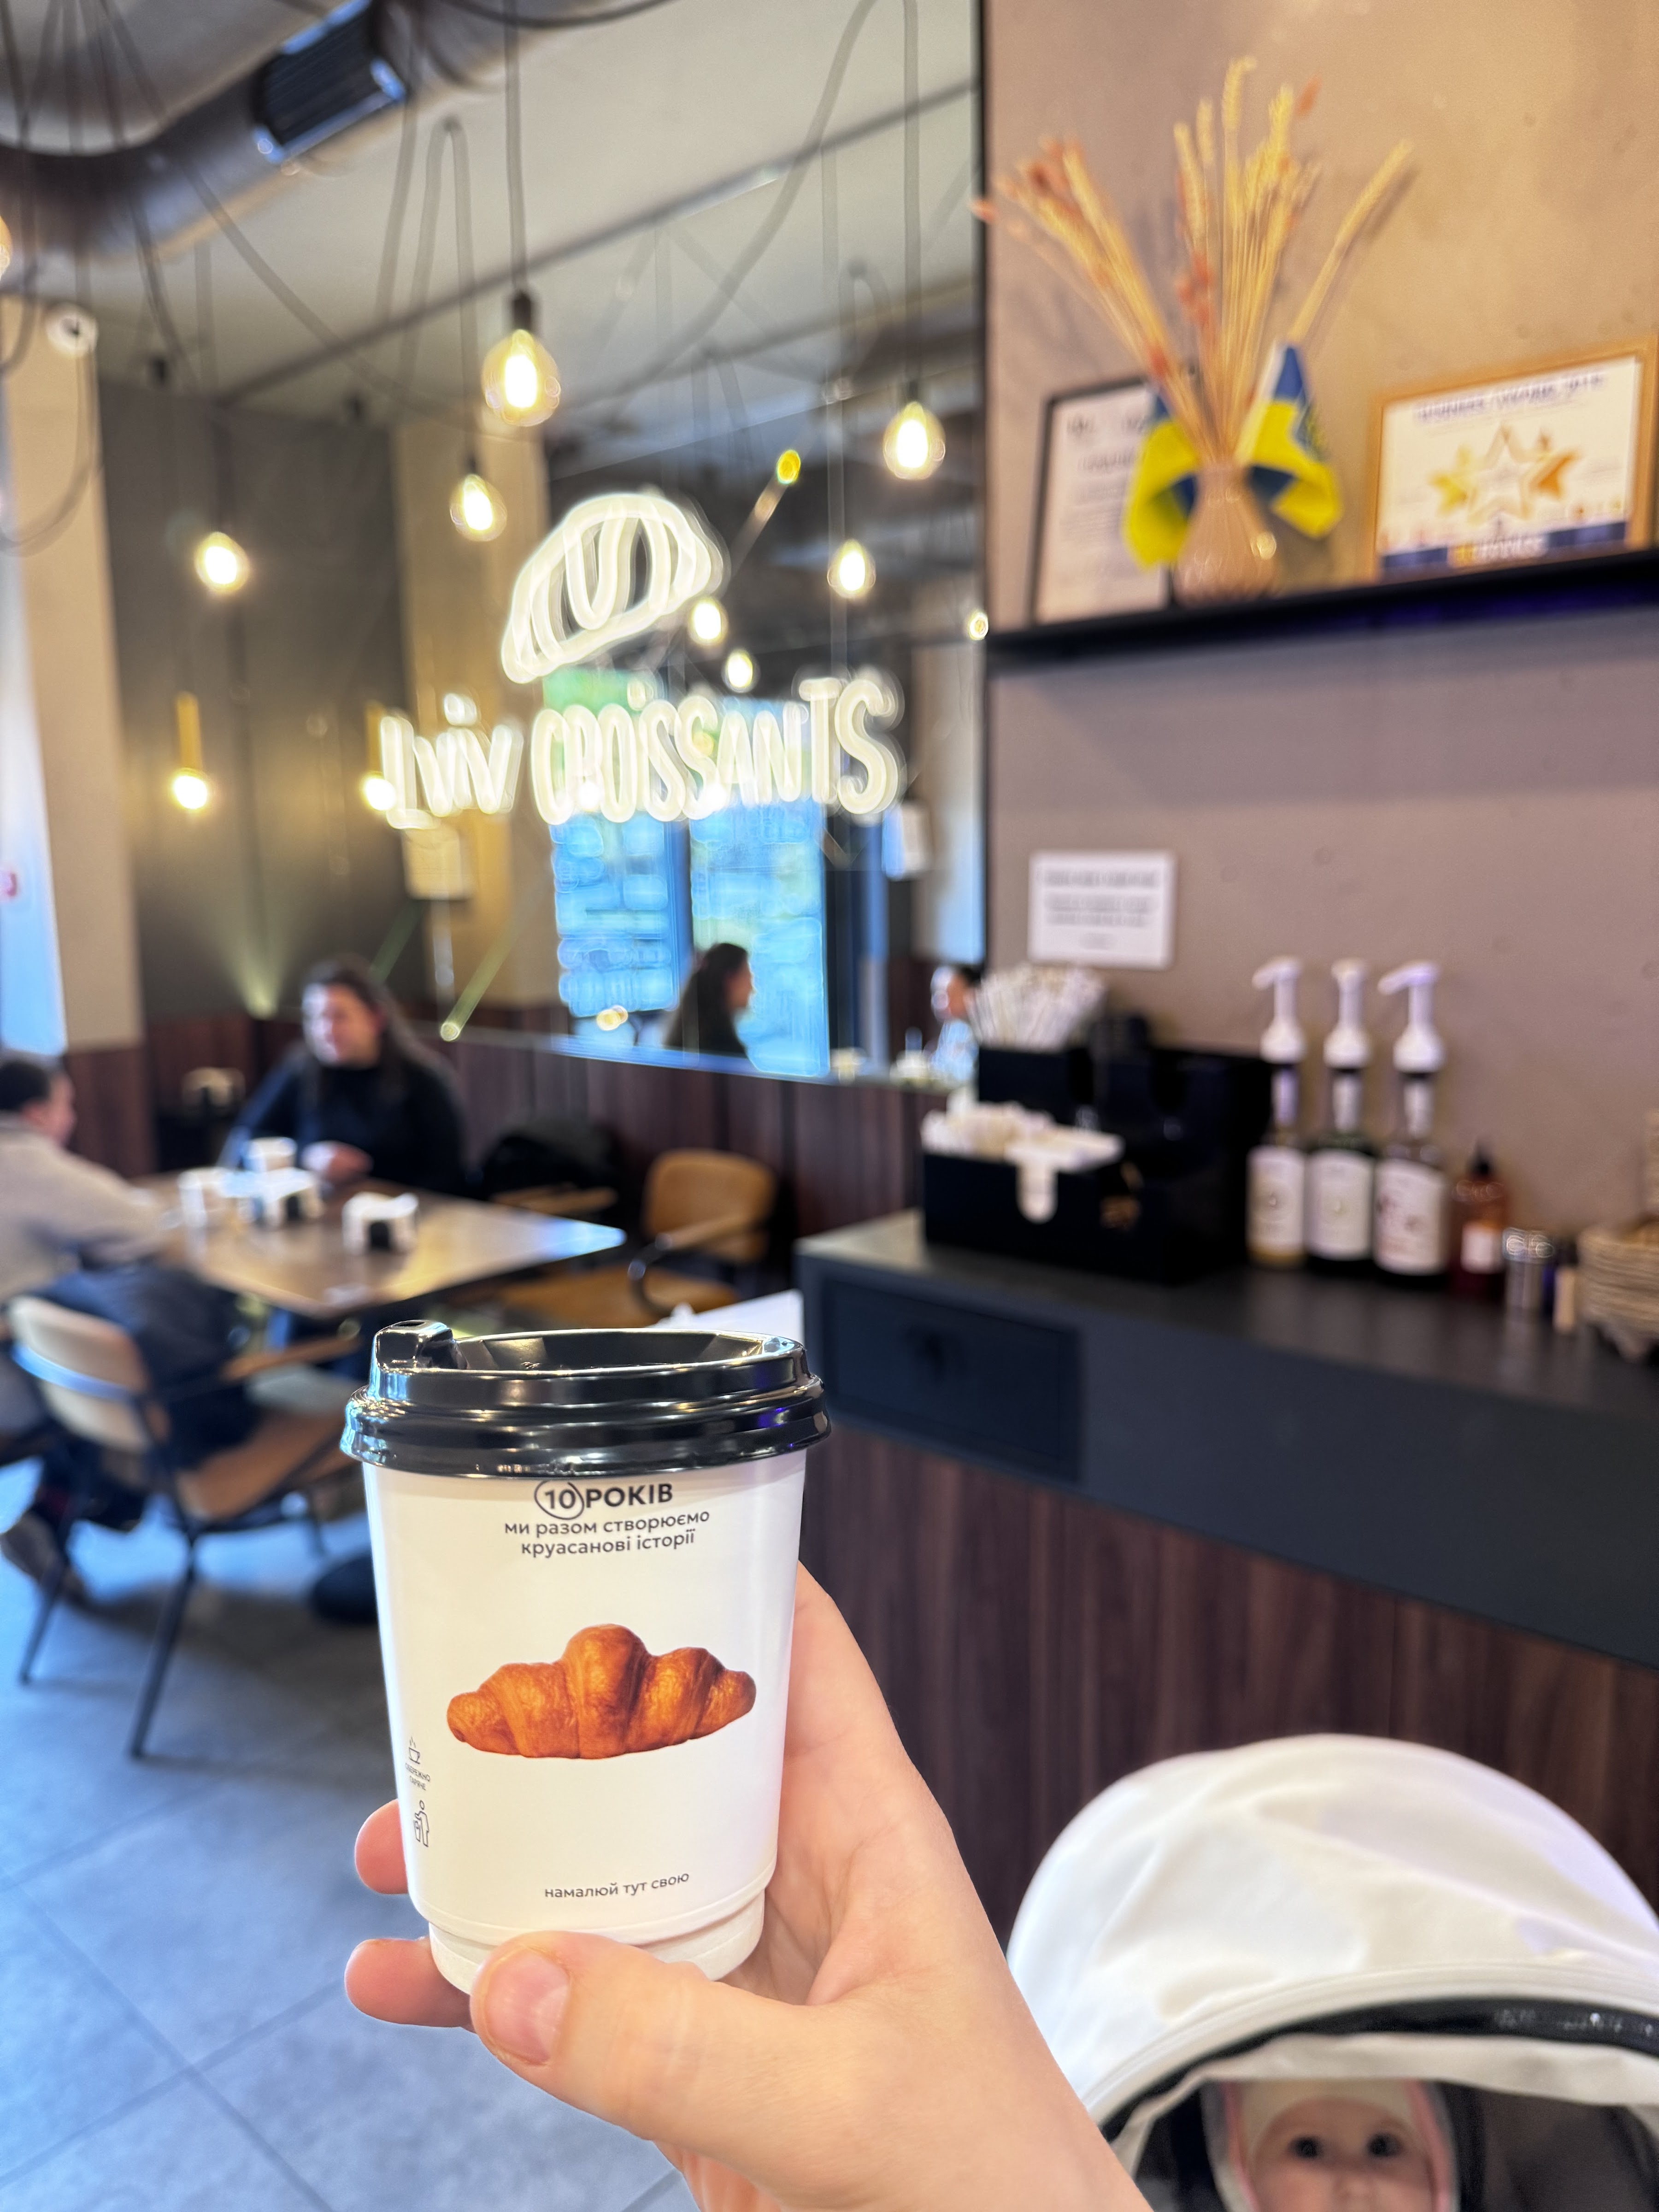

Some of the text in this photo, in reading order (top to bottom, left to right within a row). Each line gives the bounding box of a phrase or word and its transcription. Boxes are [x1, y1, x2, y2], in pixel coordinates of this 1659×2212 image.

[545, 1483, 673, 1509] 10 РОКІВ
[505, 1511, 710, 1537] ми разом створюємо
[521, 1528, 694, 1558] круасанові історії
[545, 1873, 689, 1897] намалюй тут свою
